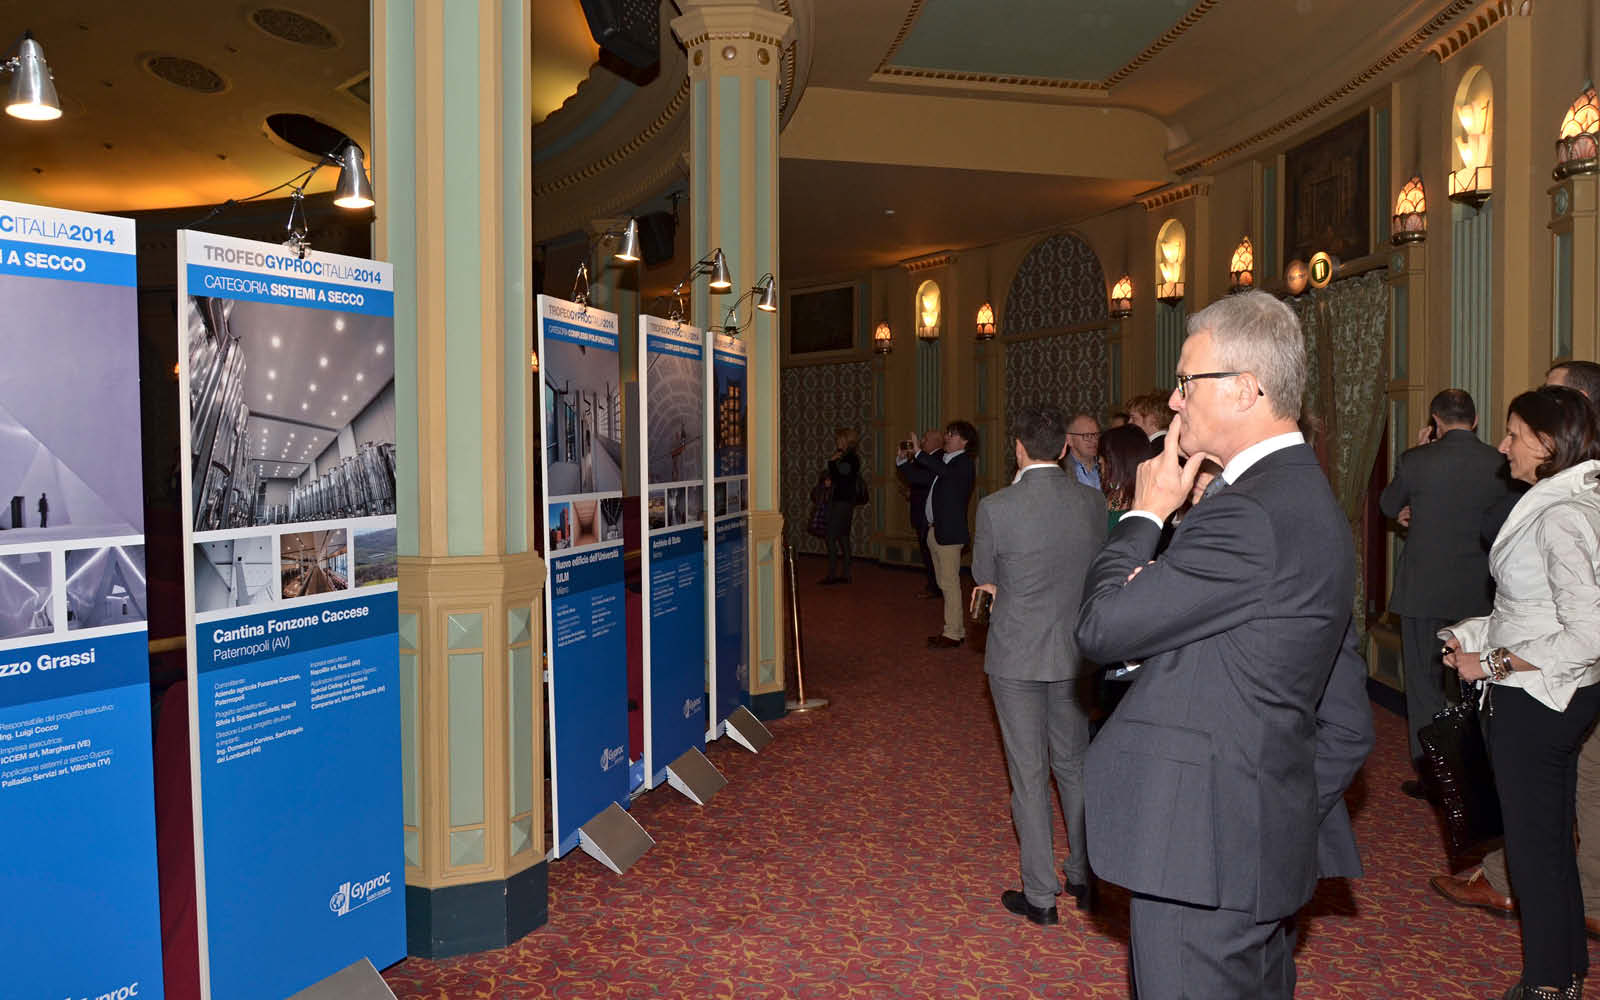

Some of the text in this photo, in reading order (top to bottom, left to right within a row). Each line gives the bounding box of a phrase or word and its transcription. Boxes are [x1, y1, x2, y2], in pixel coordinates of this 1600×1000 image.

[7, 250, 21, 266] A
[24, 252, 87, 272] SECCO
[204, 245, 381, 284] TROFEOGYPROCITALIA2014
[204, 275, 365, 307] CATEGORIA SISTEMI A SECCO
[556, 560, 571, 570] Nuovo
[572, 555, 589, 567] edificio
[556, 572, 570, 584] IULM
[213, 606, 369, 644] Cantina Fonzone Caccese
[36, 648, 96, 671] Grassi
[213, 635, 291, 662] Paternopoli (AV)
[15, 728, 34, 739] Luigi
[34, 724, 59, 735] Cocco
[41, 744, 76, 757] Marghera
[1, 775, 32, 788] Palladio
[32, 770, 57, 781] Servizi
[70, 761, 97, 773] Villorba
[351, 872, 391, 899] Gyproc
